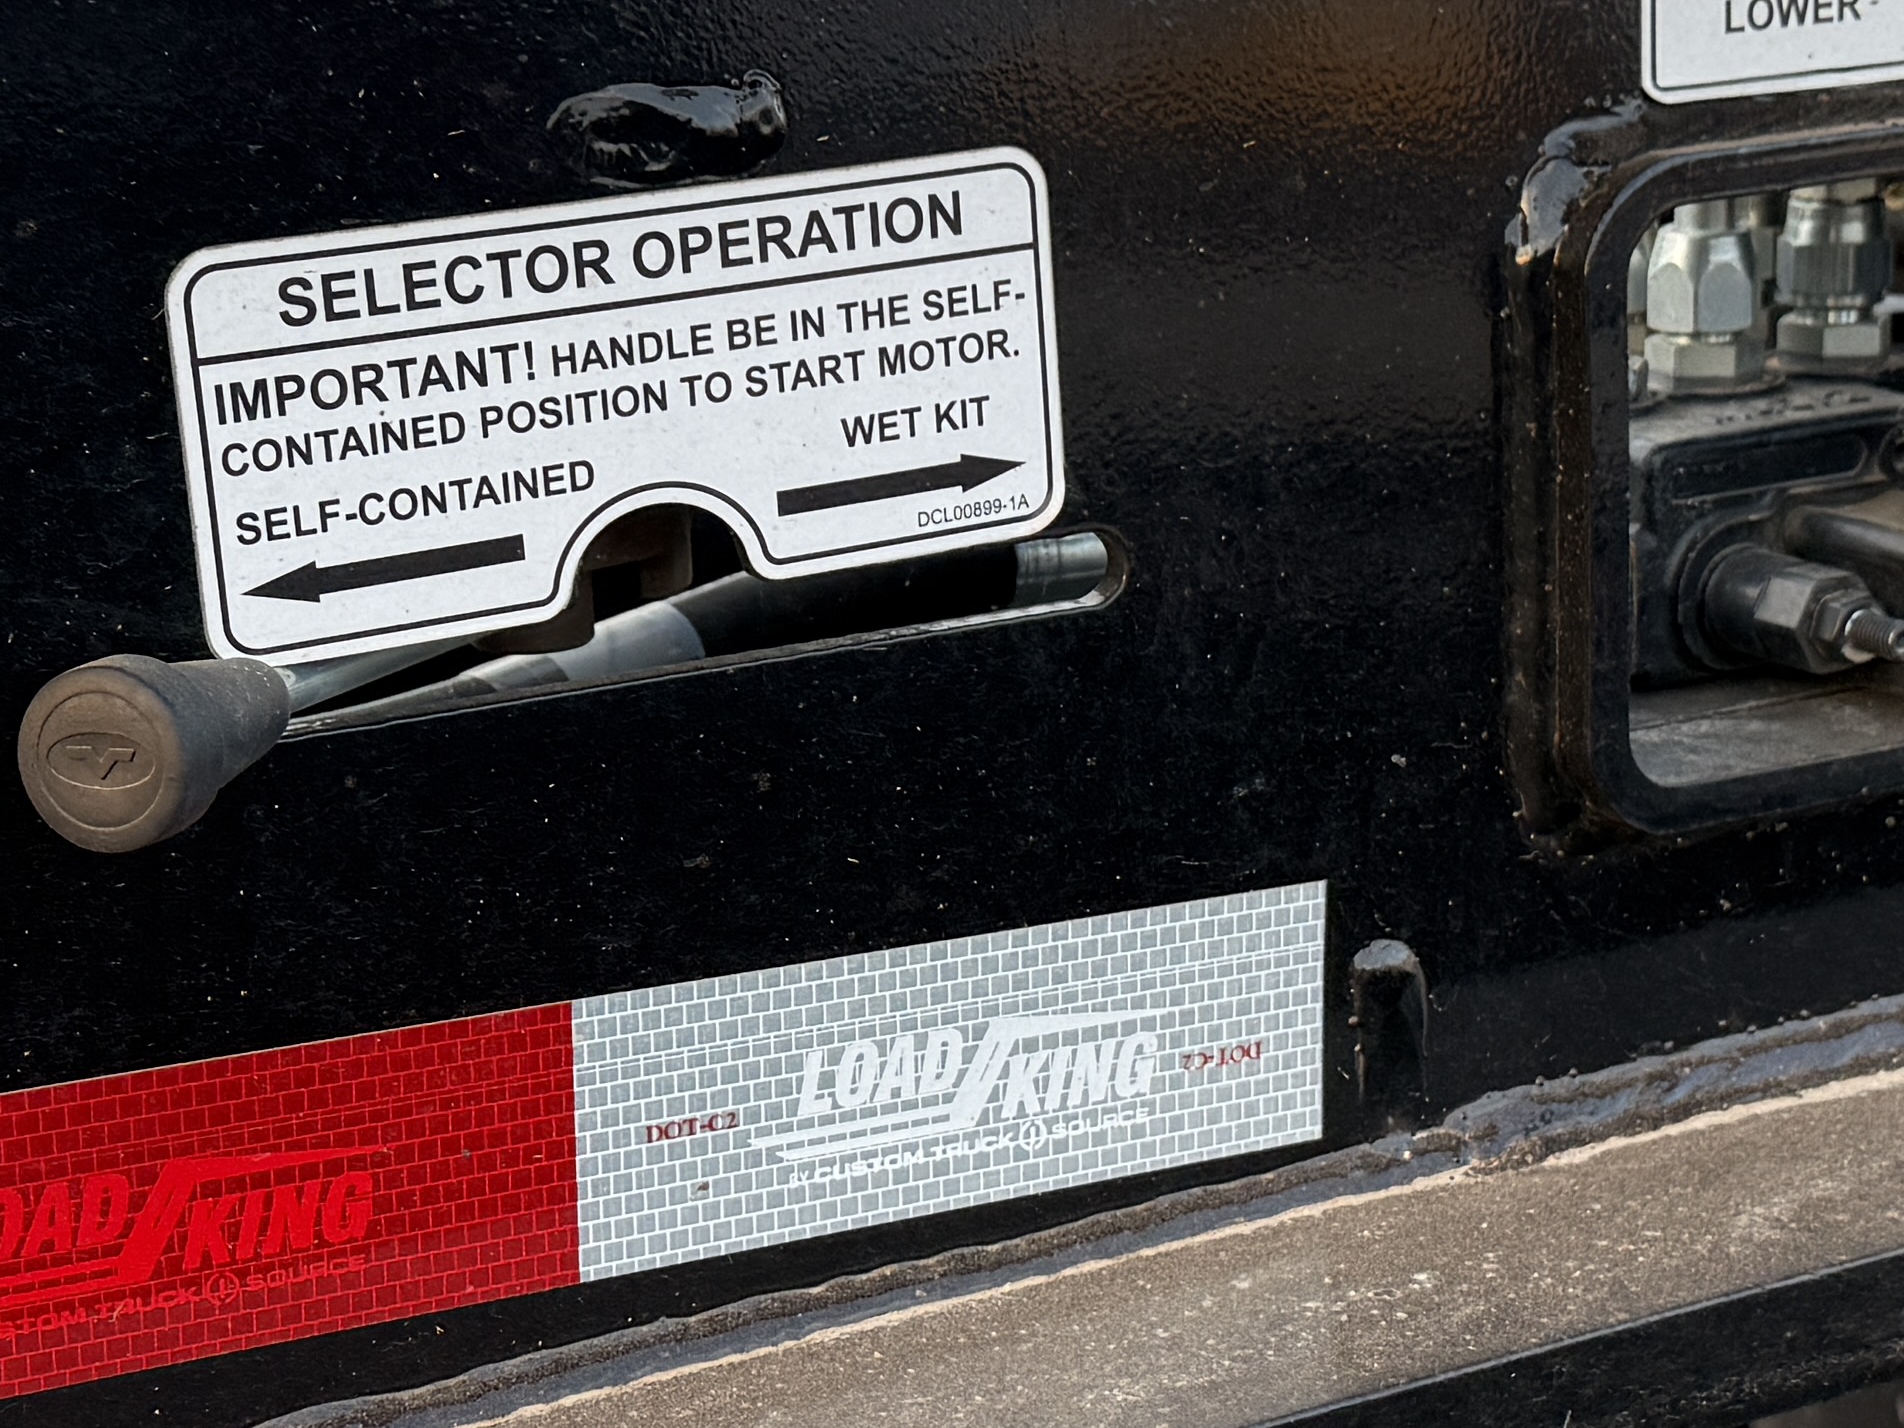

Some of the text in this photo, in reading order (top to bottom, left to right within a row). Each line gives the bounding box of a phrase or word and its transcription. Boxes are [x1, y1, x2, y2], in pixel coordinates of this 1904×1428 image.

[277, 190, 964, 329] SELECTOR OPERATION
[215, 280, 1026, 426] IMPORTANT! HANDLE BE IN THE SELF-
[221, 328, 1020, 478] CONTAINED POSITION TO START MOTOR.
[840, 396, 991, 449] WET KIT
[236, 460, 596, 547] SELF-CONTAINED
[916, 494, 1030, 529] DCL00899-1A
[646, 1112, 739, 1143] DOT-C2
[788, 1169, 809, 1188] BY
[815, 1150, 924, 1183] CUSTOM
[931, 1132, 1013, 1161] TRUCK
[1052, 1108, 1150, 1139] SOURCE
[95, 1286, 198, 1322] TRUCK
[247, 1254, 365, 1291] SOURCE
